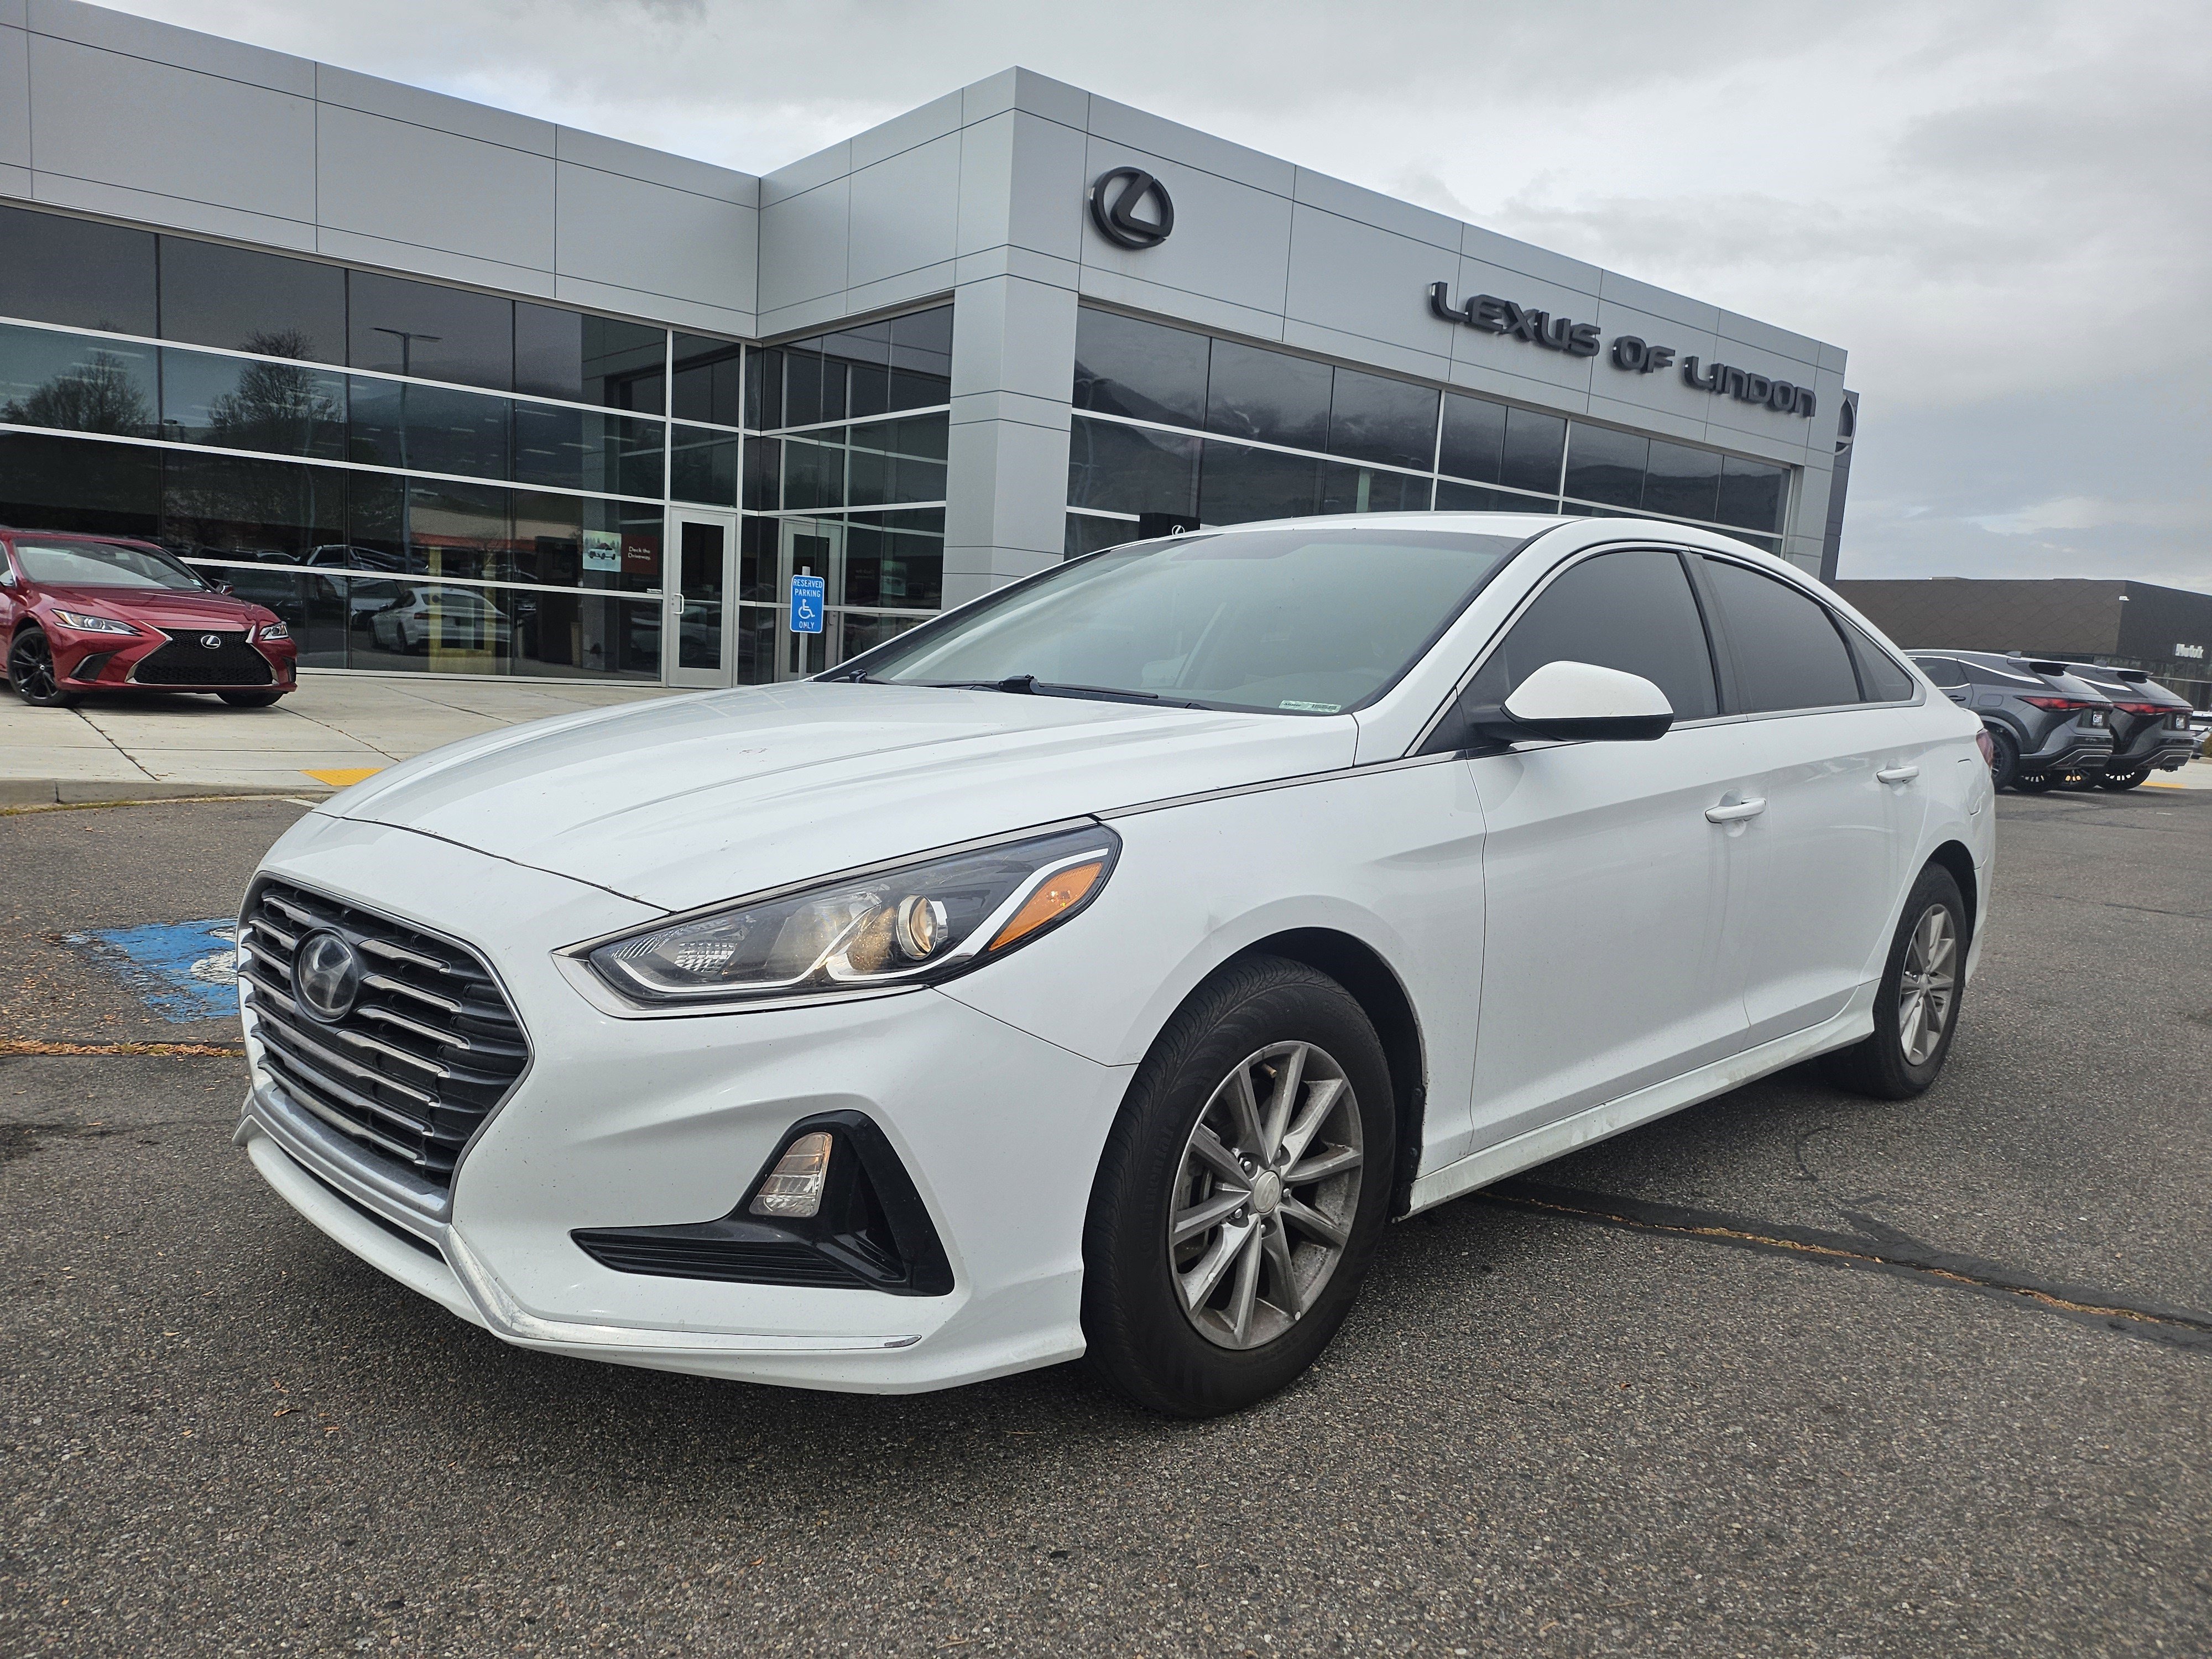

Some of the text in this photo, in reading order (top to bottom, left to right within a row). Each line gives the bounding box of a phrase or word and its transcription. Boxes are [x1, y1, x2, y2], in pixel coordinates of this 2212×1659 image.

[1431, 281, 1816, 417] LEXUS OF LINDON
[793, 579, 822, 588] RESERVED
[795, 588, 821, 597] PARKING
[799, 621, 814, 629] ONLY
